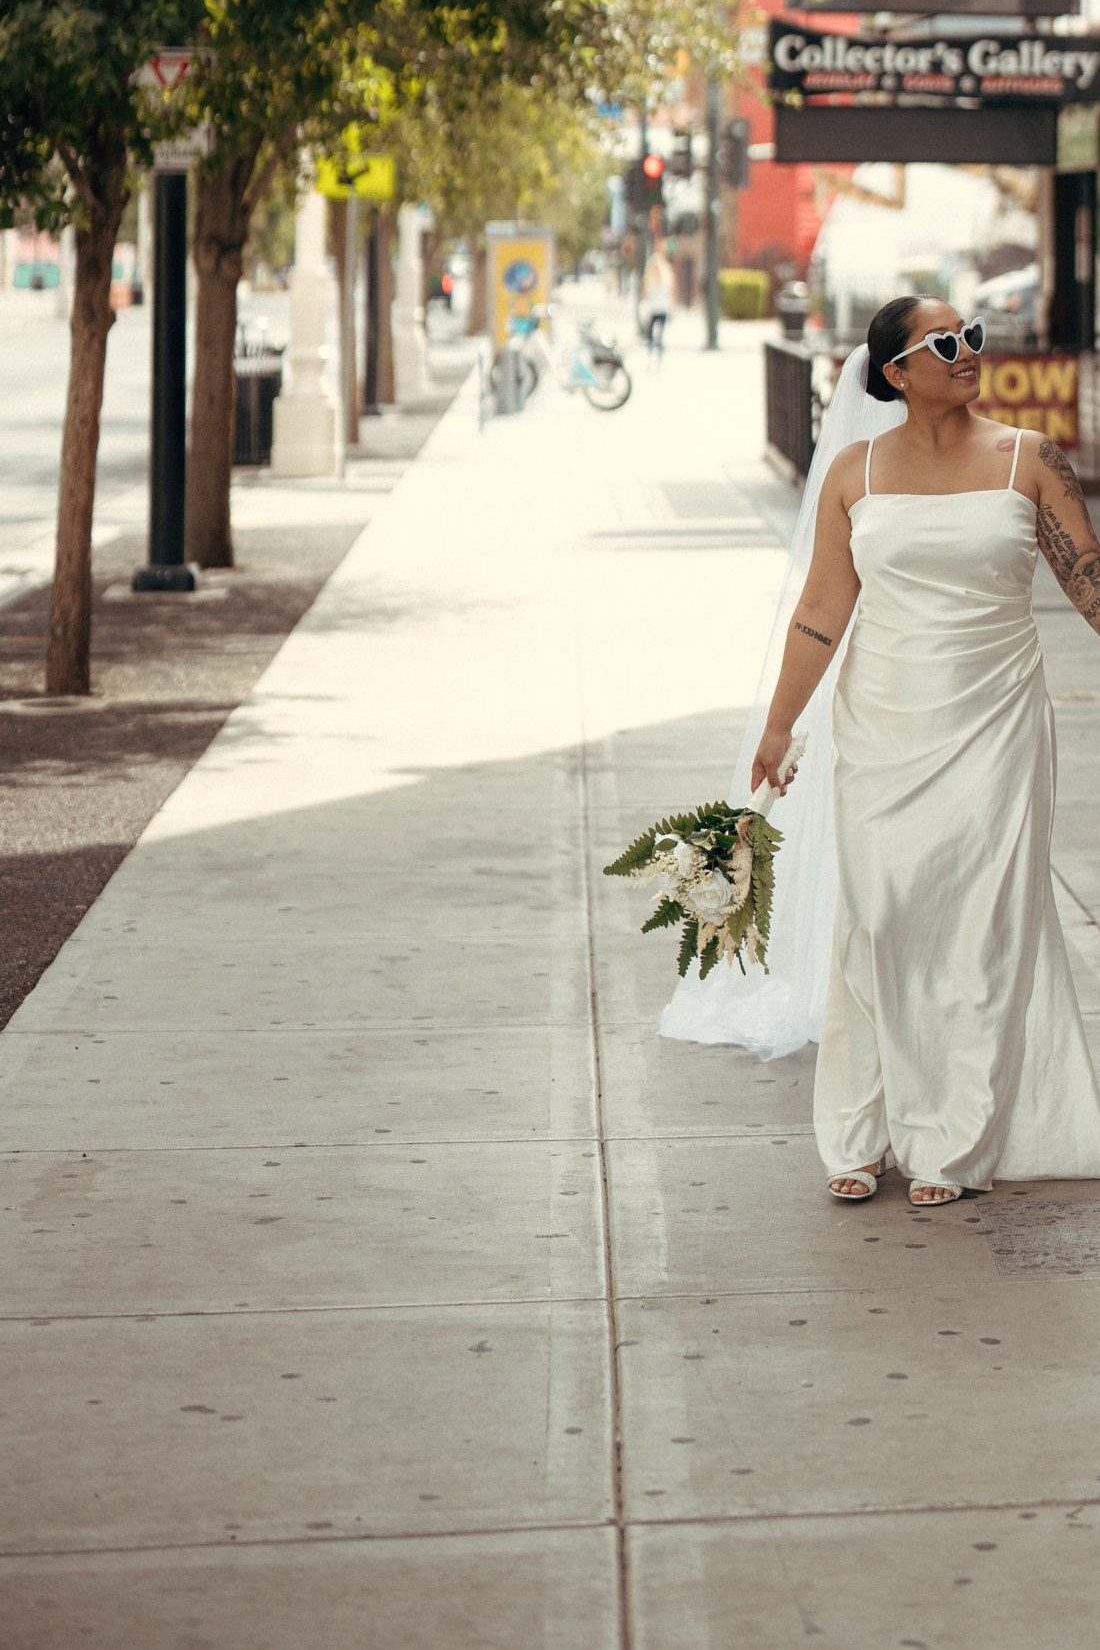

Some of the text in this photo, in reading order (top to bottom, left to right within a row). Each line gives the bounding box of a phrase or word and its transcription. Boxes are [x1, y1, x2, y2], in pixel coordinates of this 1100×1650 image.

[773, 34, 963, 76] Collector's
[967, 39, 1100, 89] Gallery
[980, 407, 1077, 443] PEN
